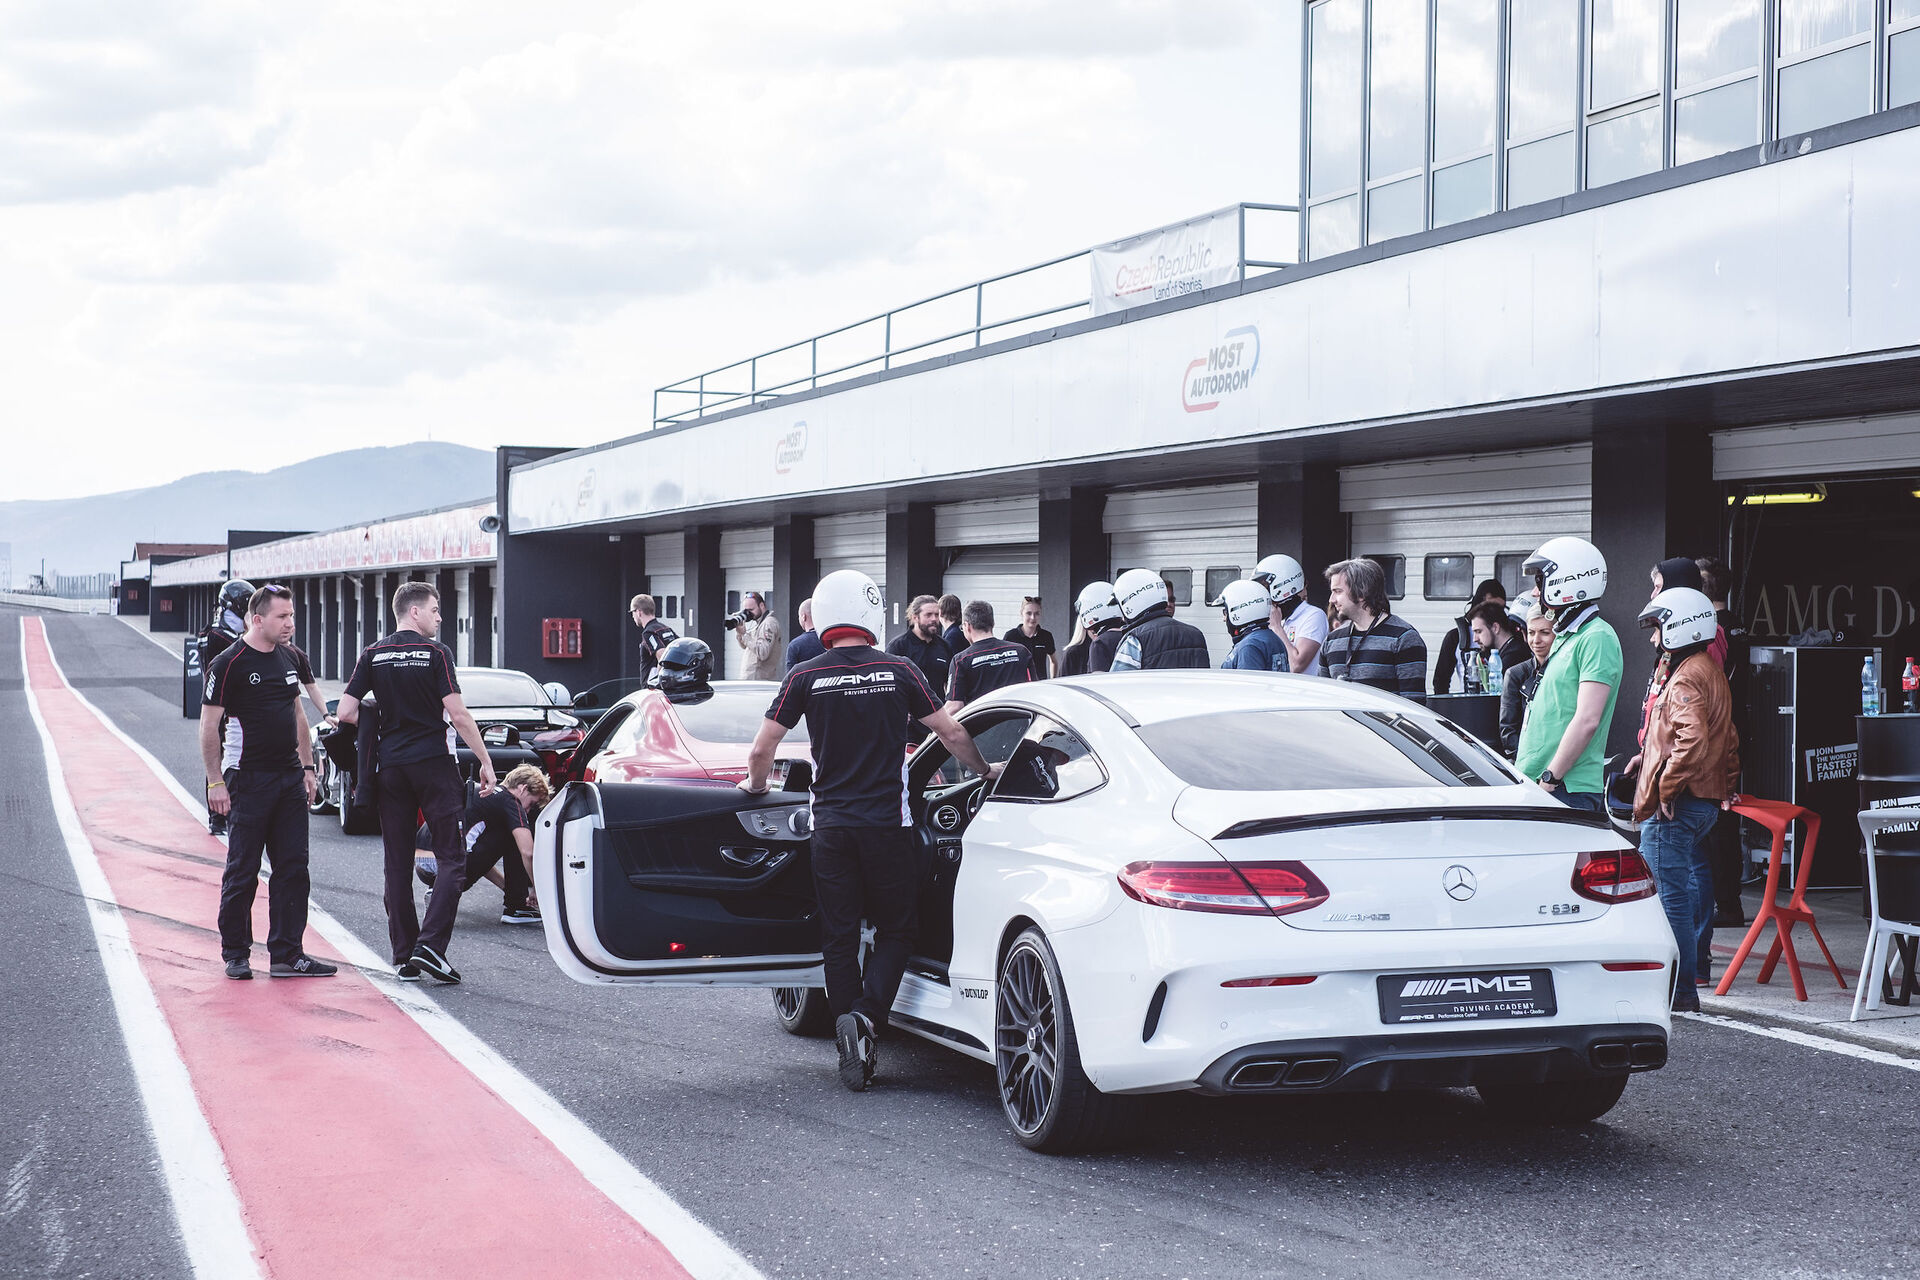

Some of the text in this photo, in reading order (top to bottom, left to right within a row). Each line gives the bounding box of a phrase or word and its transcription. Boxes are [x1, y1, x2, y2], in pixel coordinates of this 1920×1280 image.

[1153, 277, 1203, 300] Land of Stories
[1208, 342, 1245, 372] MOST
[1190, 368, 1250, 398] AUTODROM
[1564, 567, 1600, 583] AMG
[1129, 583, 1154, 600] AMG
[1240, 597, 1264, 608] AMG
[1748, 583, 1857, 637] AMG
[1681, 611, 1713, 625] AMG
[188, 649, 200, 665] 2
[390, 651, 431, 660] AMG
[986, 650, 1018, 661] AMG
[837, 672, 895, 686] AMG
[1816, 746, 1834, 757] JOIN
[1829, 752, 1858, 760] WORLD'S
[1816, 758, 1858, 772] FASTEST
[1817, 768, 1853, 781] FAMILY
[1880, 798, 1898, 809] JOIN
[1538, 905, 1548, 914] C
[1348, 913, 1391, 921] AMG
[1439, 975, 1532, 995] AMG
[964, 988, 989, 999] DUNLOP
[1454, 1002, 1535, 1013] DRIVING ACADEMY
